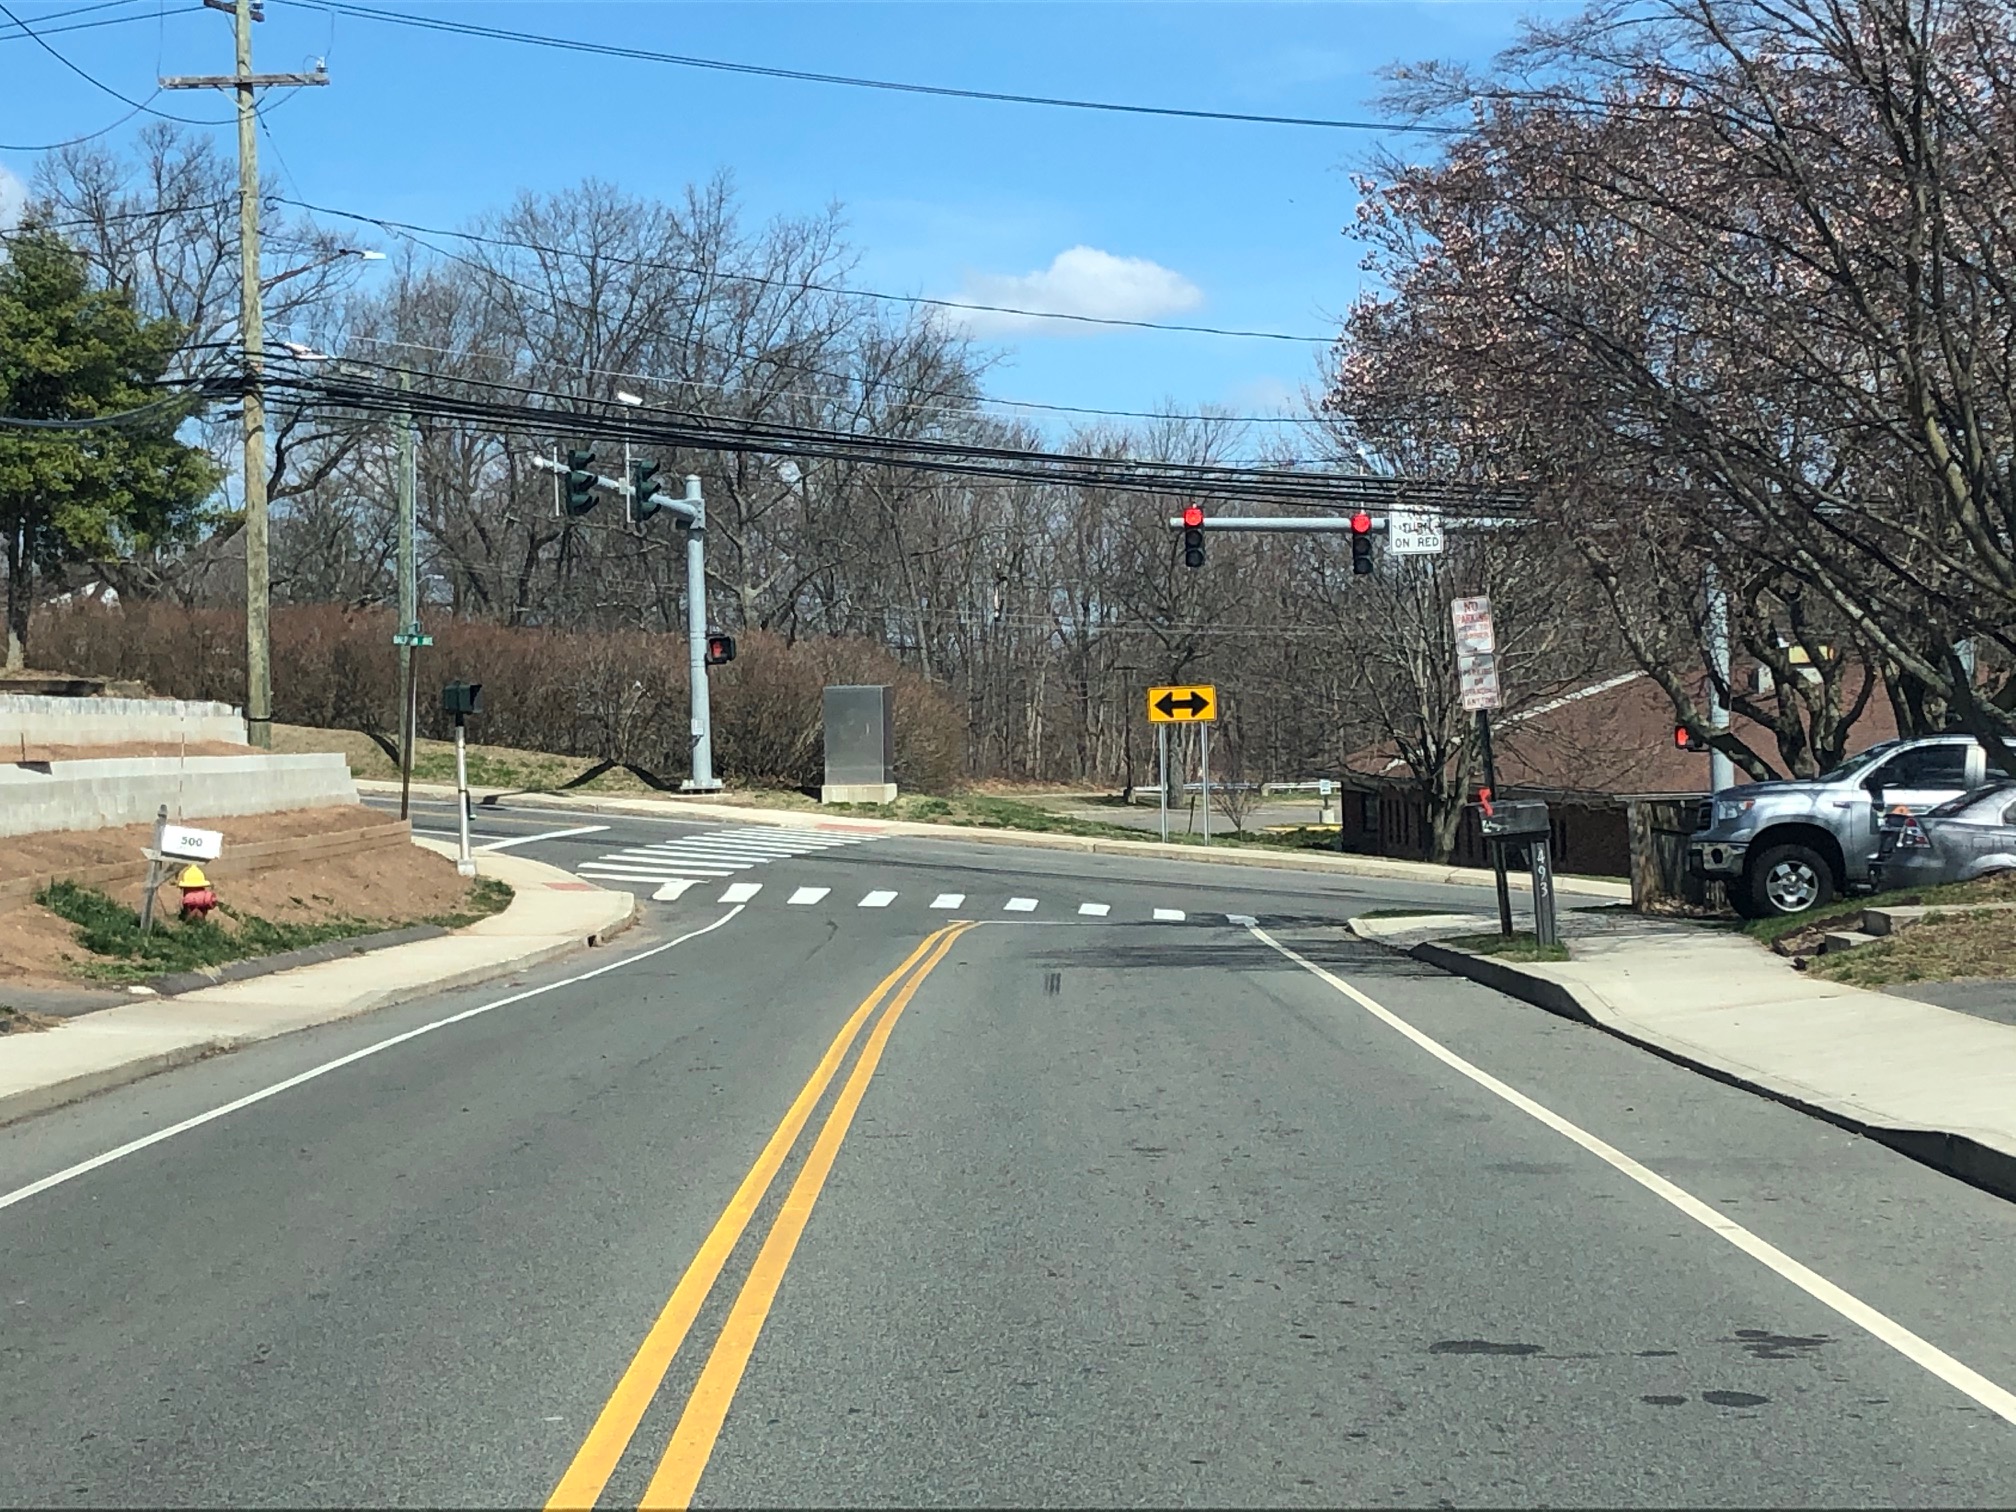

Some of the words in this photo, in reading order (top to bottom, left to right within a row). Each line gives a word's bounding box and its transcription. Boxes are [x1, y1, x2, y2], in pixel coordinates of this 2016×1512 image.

[1395, 538, 1410, 548] ON
[1417, 537, 1439, 547] RED
[1464, 601, 1478, 612] NO
[181, 836, 203, 847] 500
[1537, 849, 1548, 897] 493
